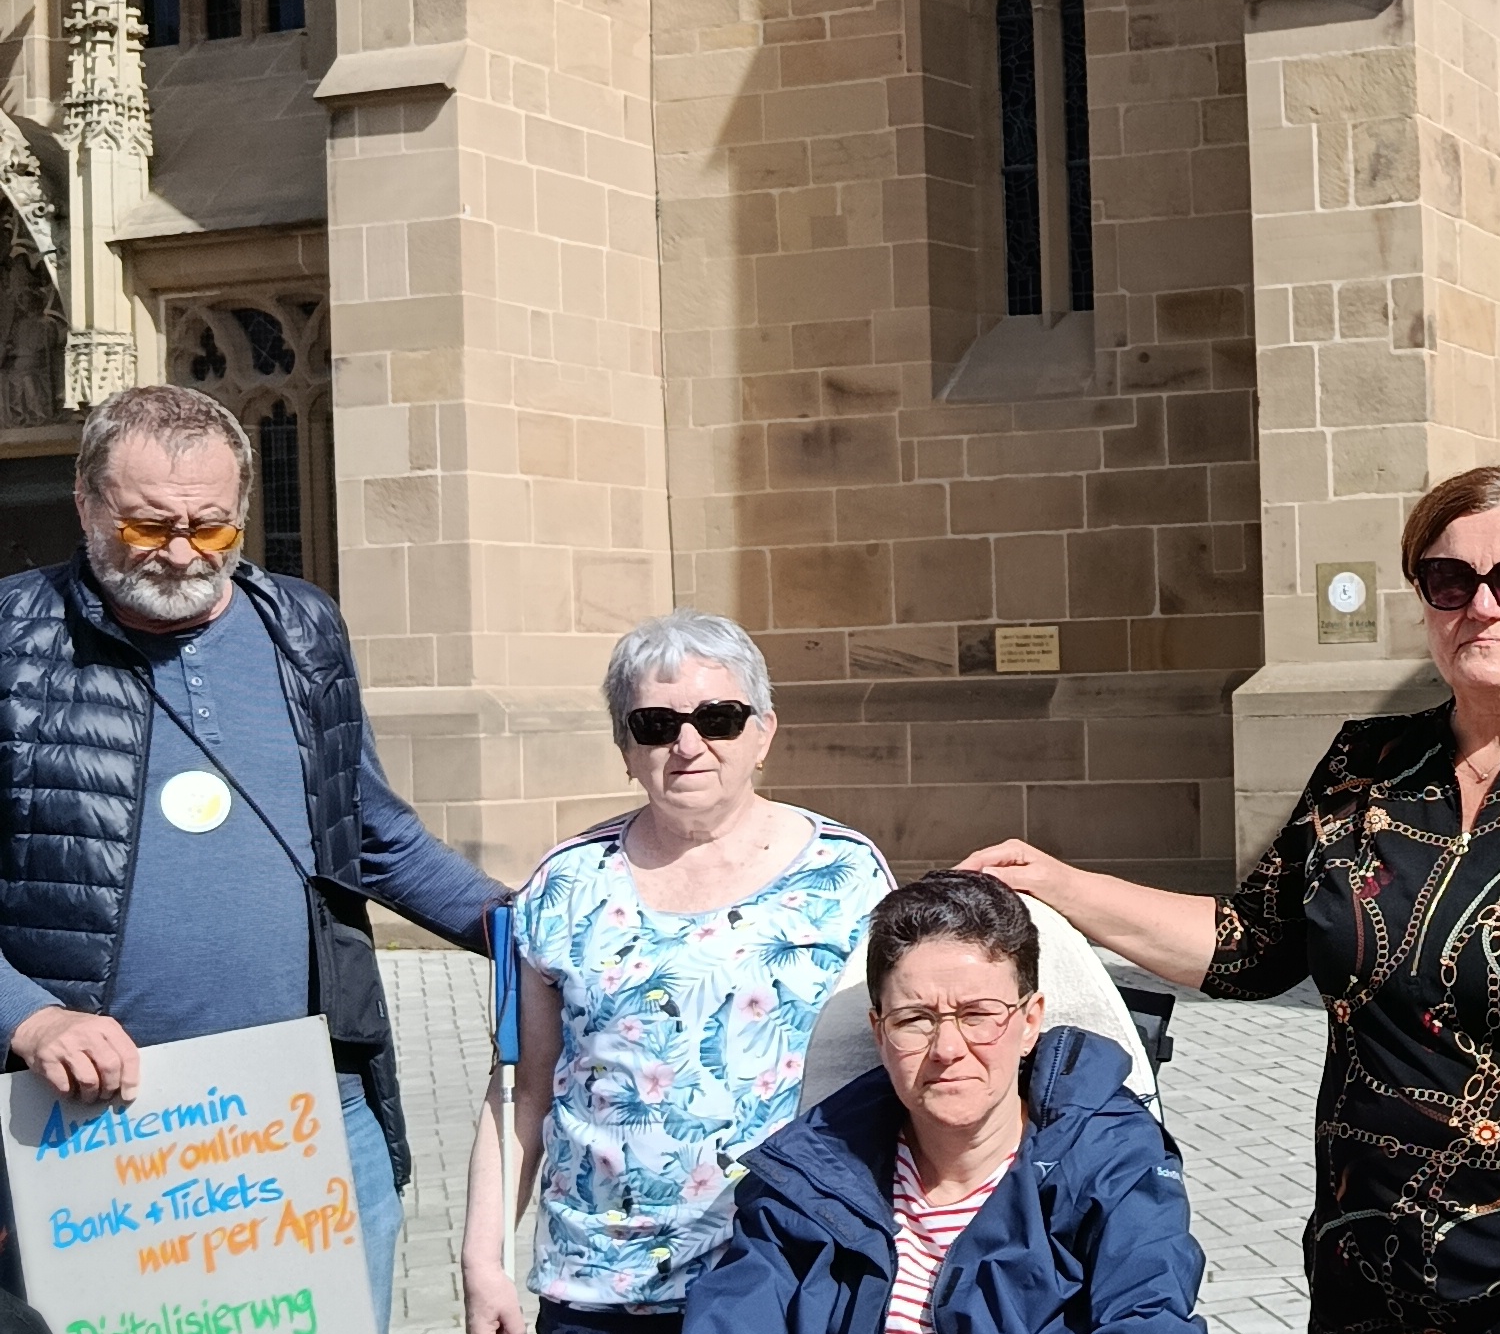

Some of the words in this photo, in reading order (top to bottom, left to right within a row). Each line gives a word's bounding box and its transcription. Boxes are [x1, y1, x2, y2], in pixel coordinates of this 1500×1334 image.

[37, 1086, 247, 1161] Arzttermin
[115, 1143, 177, 1185] nur
[179, 1092, 321, 1171] online?
[50, 1198, 141, 1250] Bank
[161, 1173, 284, 1221] Tickets
[138, 1230, 197, 1275] nur
[204, 1215, 269, 1274] per
[273, 1176, 356, 1255] App?
